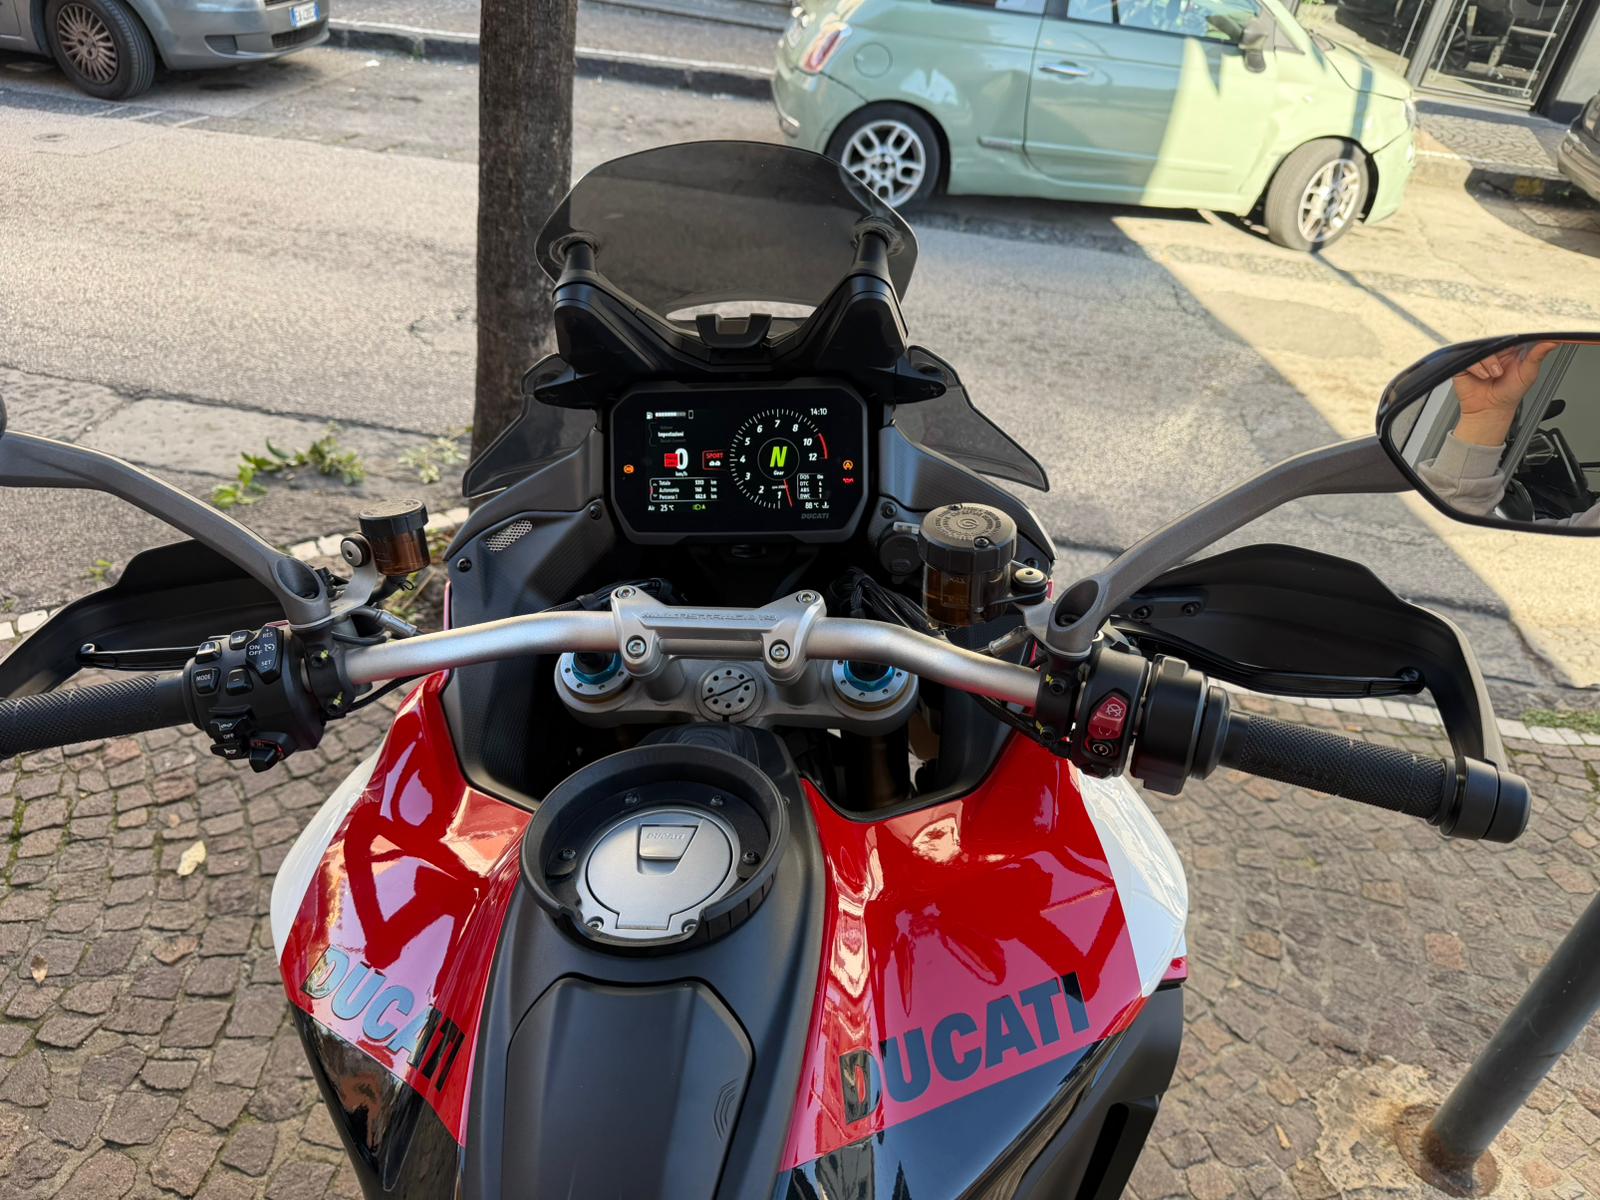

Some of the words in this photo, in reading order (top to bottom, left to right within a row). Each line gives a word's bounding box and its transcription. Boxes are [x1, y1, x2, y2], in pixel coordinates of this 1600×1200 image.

[774, 420, 780, 428] 7
[792, 424, 798, 432] 8
[757, 425, 763, 433] 6
[803, 438, 813, 446] 10
[675, 448, 688, 470] 0
[739, 455, 746, 463] 4
[769, 446, 788, 467] N
[808, 453, 817, 461] 12
[744, 472, 751, 480] 3
[758, 486, 764, 494] 2
[777, 491, 782, 499] 1
[660, 504, 668, 512] 25
[196, 673, 211, 681] MODE
[301, 943, 465, 1093] DUCATI
[839, 971, 1090, 1125] DUCATI
